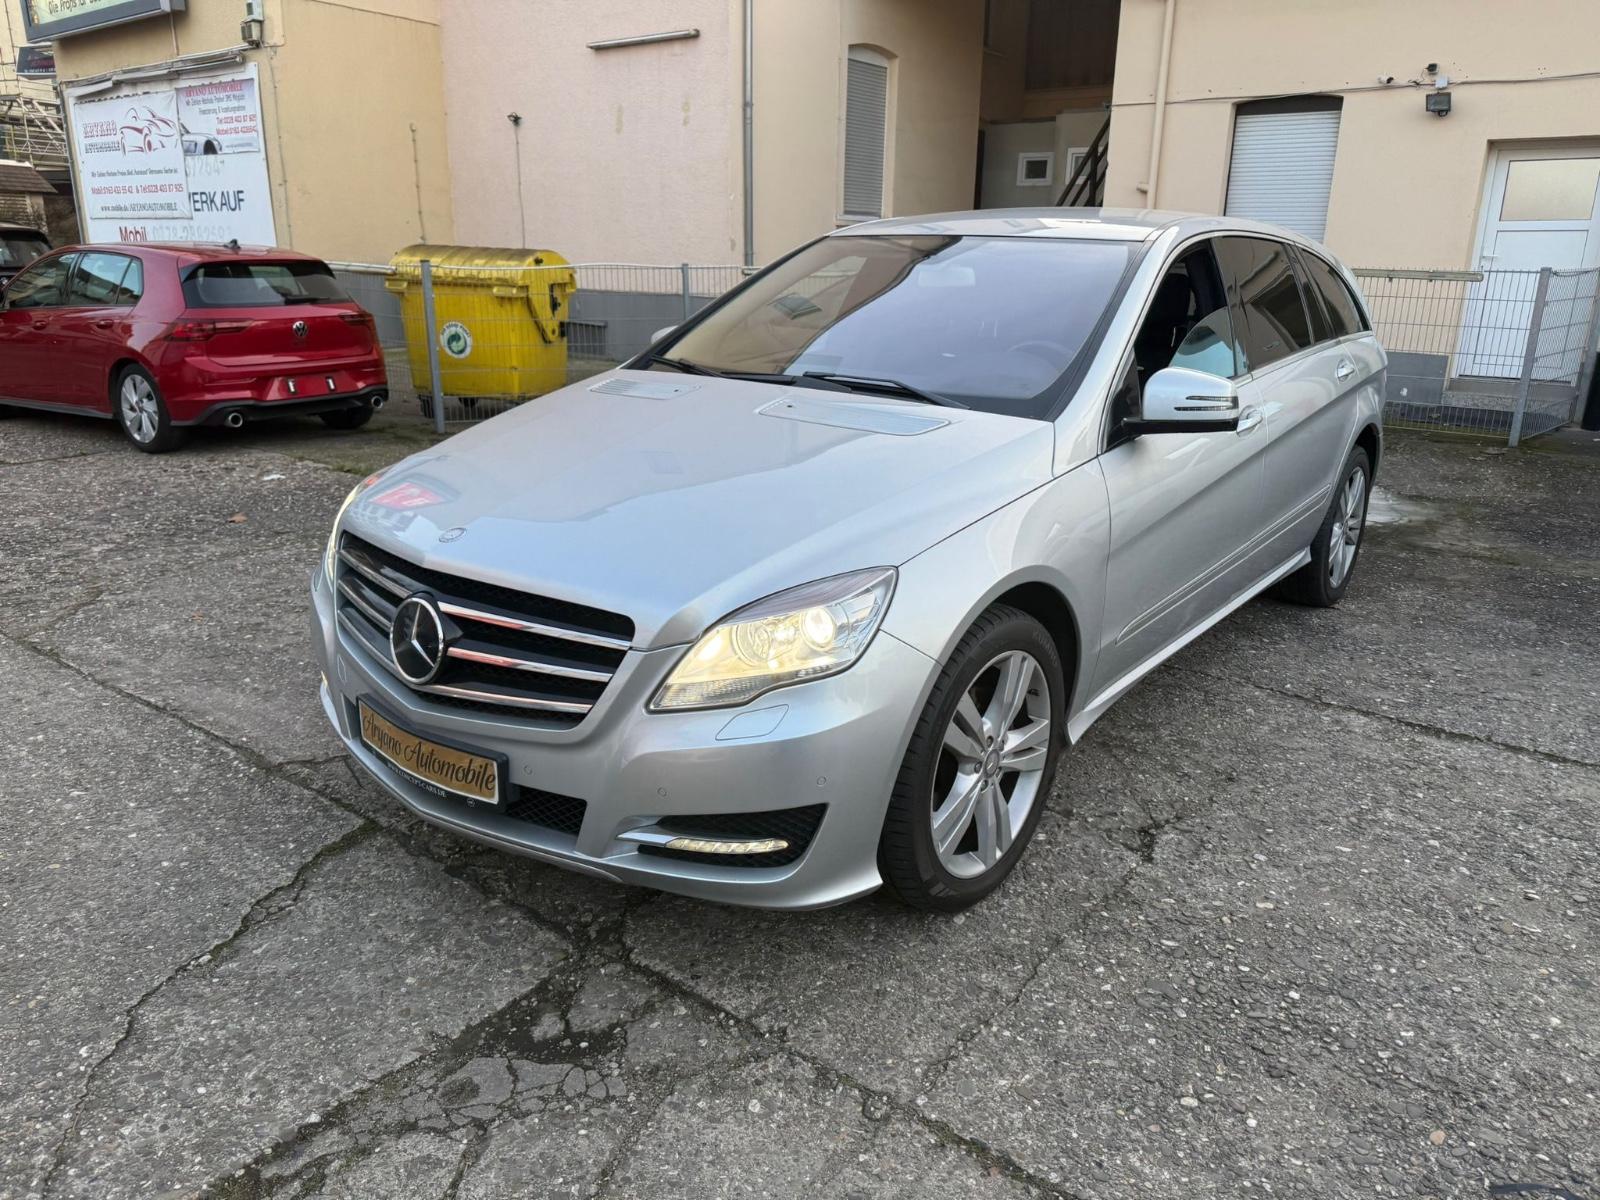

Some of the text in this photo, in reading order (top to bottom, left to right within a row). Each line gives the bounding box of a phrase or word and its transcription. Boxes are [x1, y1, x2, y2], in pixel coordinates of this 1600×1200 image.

[119, 226, 148, 242] Mobil
[363, 712, 496, 791] Aryano Automobile
